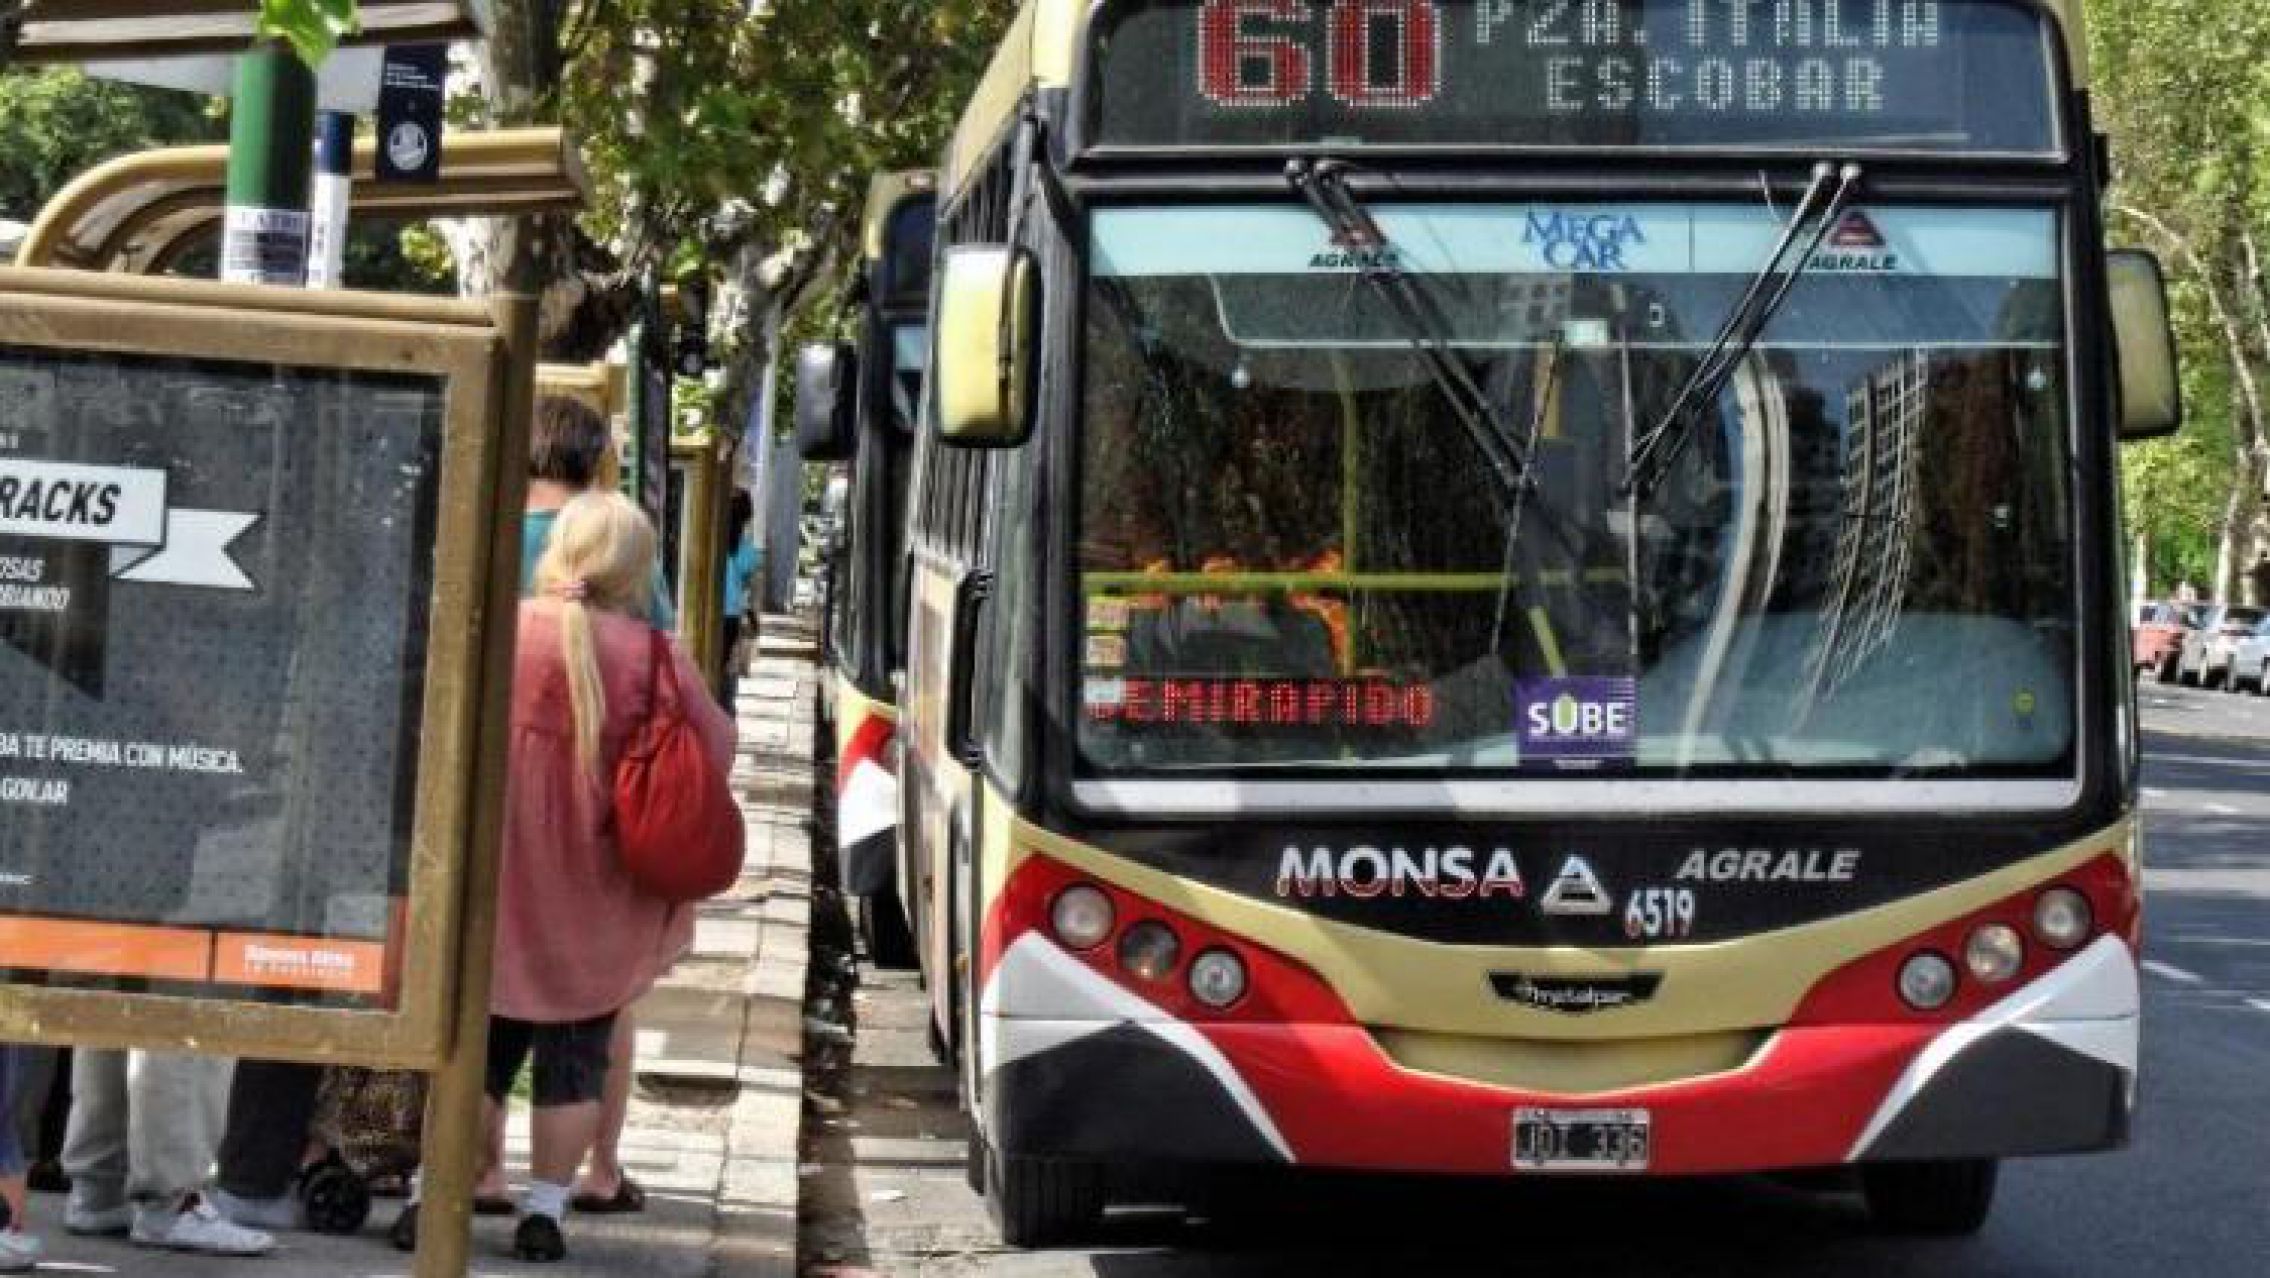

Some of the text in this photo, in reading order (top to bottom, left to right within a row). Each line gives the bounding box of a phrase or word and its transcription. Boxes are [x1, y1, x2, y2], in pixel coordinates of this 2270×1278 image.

[1475, 0, 1938, 47] PZA. ITALIA
[1196, 0, 1442, 108] 60
[1547, 56, 1884, 111] ESCOBAR
[1522, 208, 1646, 244] MEGA
[1541, 240, 1629, 271] CAR
[1808, 253, 1898, 271] AGRALE
[1527, 691, 1627, 736] SUBE
[25, 735, 49, 760] TE
[51, 737, 120, 764] PREMIA
[125, 744, 163, 768] CON
[1276, 846, 1525, 899] MONSA
[1675, 849, 1860, 882] AGRALE
[1623, 888, 1696, 940] 6519
